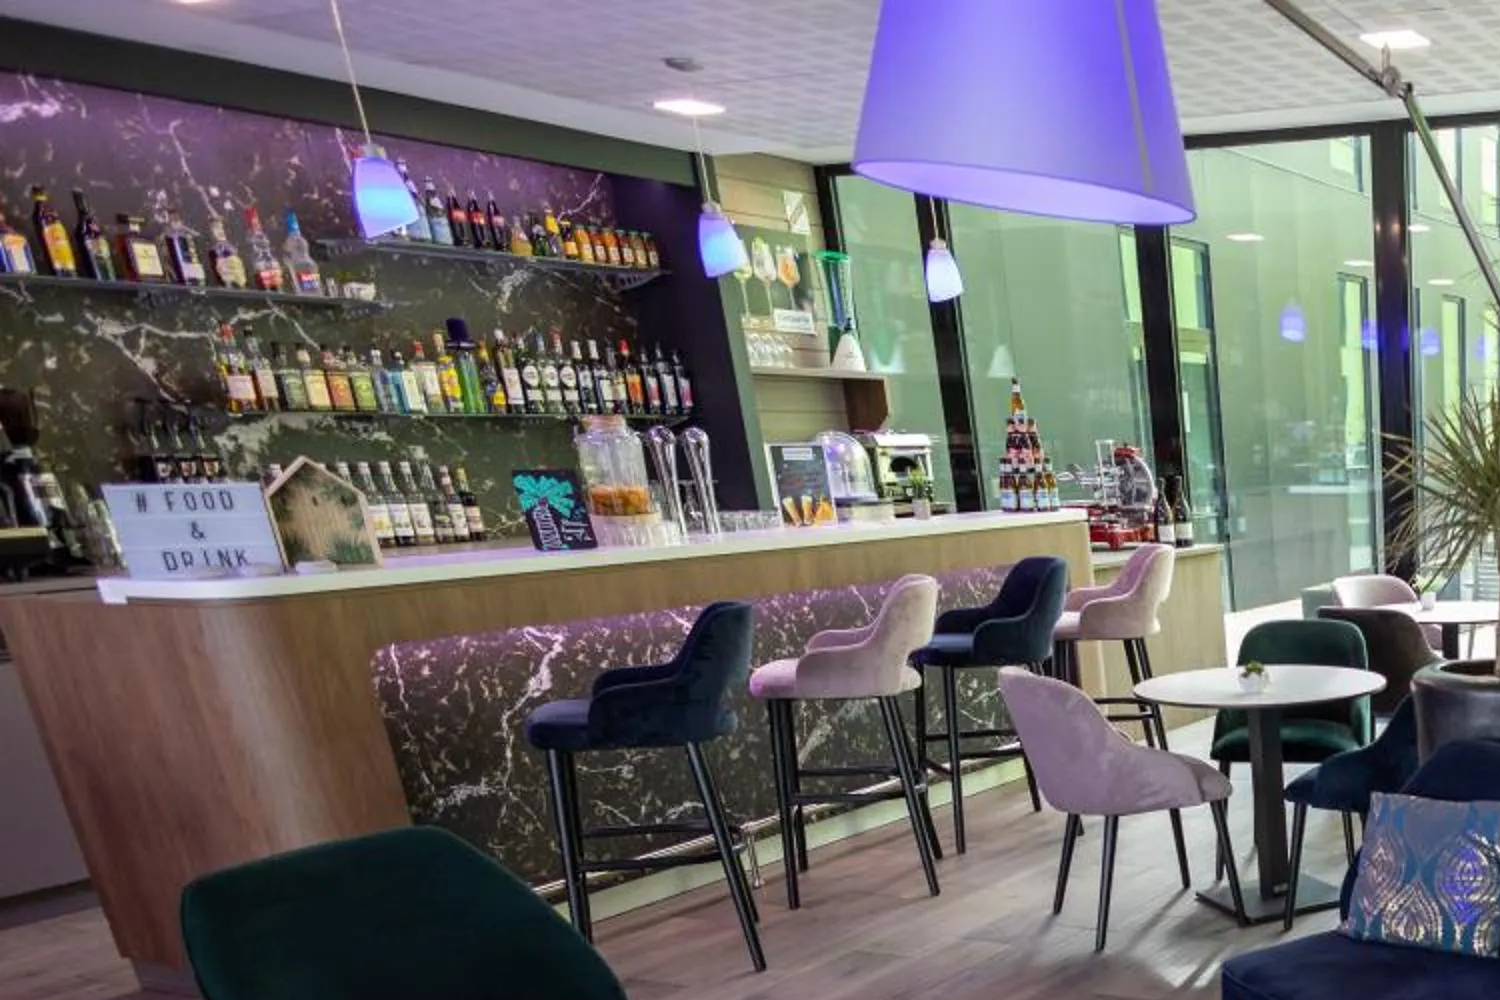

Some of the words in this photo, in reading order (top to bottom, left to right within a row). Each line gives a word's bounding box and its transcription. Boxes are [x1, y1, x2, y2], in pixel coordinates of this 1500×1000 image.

[164, 490, 234, 512] FOOD
[191, 522, 206, 540] &
[162, 549, 249, 571] DRINK
